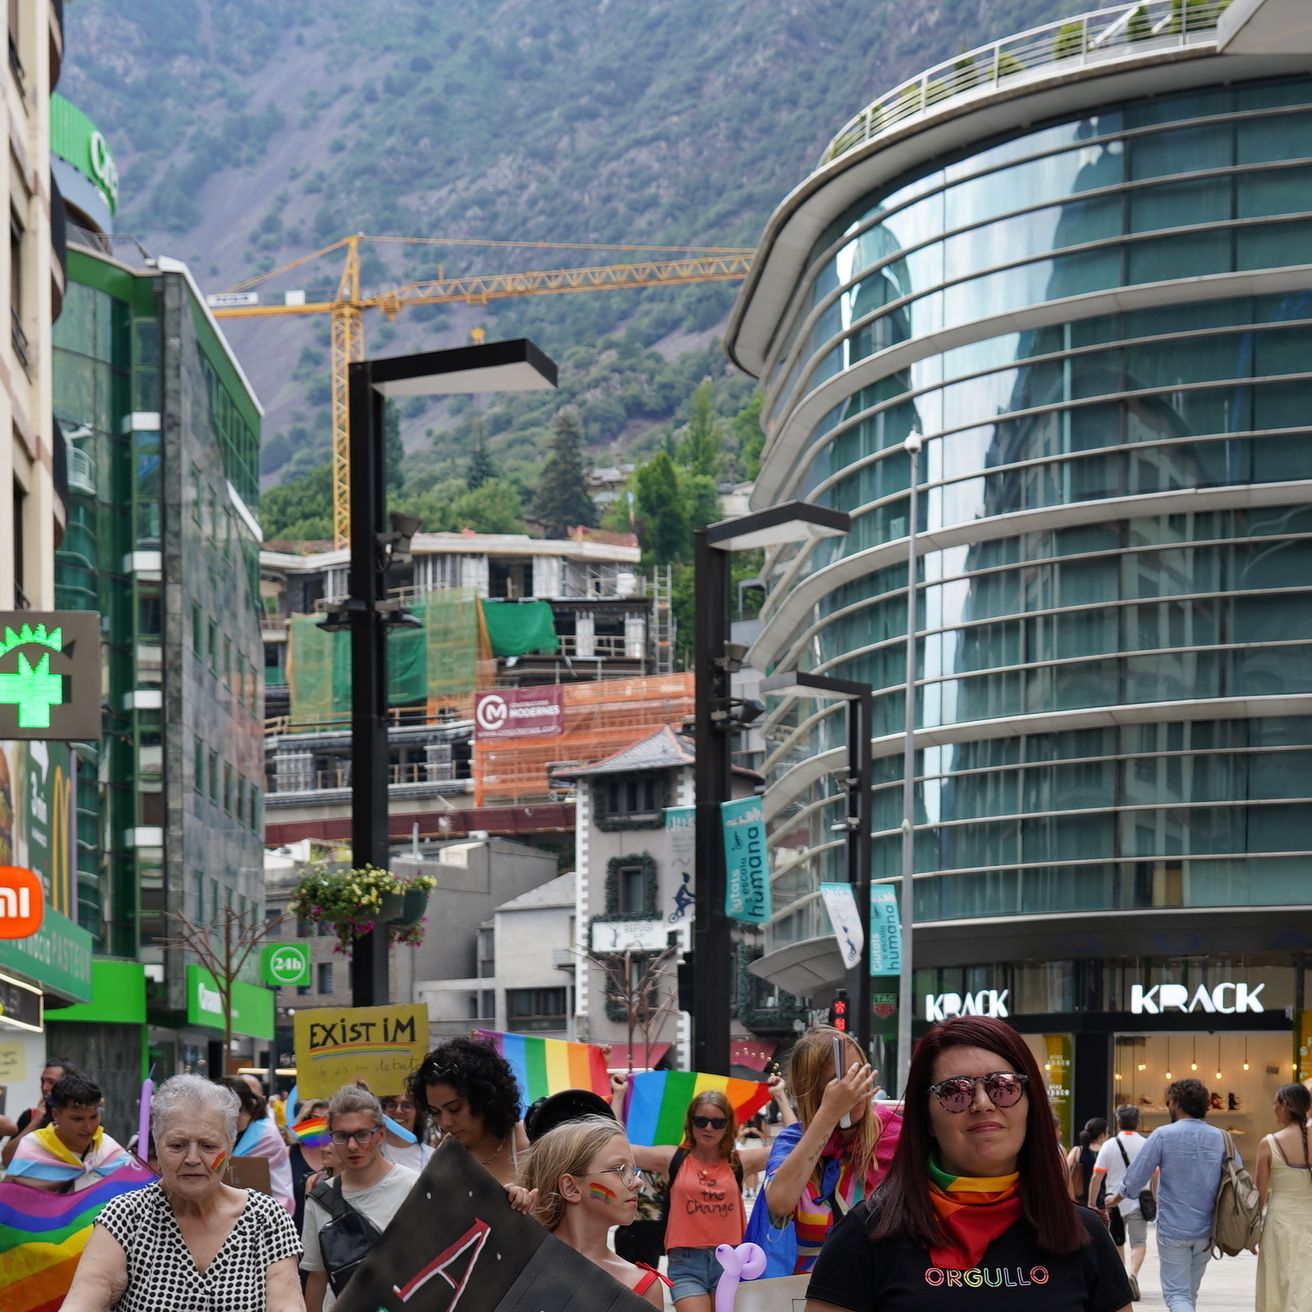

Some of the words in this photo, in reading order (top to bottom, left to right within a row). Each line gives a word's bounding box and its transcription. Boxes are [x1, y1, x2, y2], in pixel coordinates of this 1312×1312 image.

[747, 826, 764, 918] humana
[887, 904, 901, 970] humana
[273, 957, 302, 971] 24h
[1130, 982, 1266, 1015] KRACK
[701, 1189, 725, 1201] the
[686, 1200, 735, 1217] Change
[924, 1265, 1050, 1288] ORGULLO
